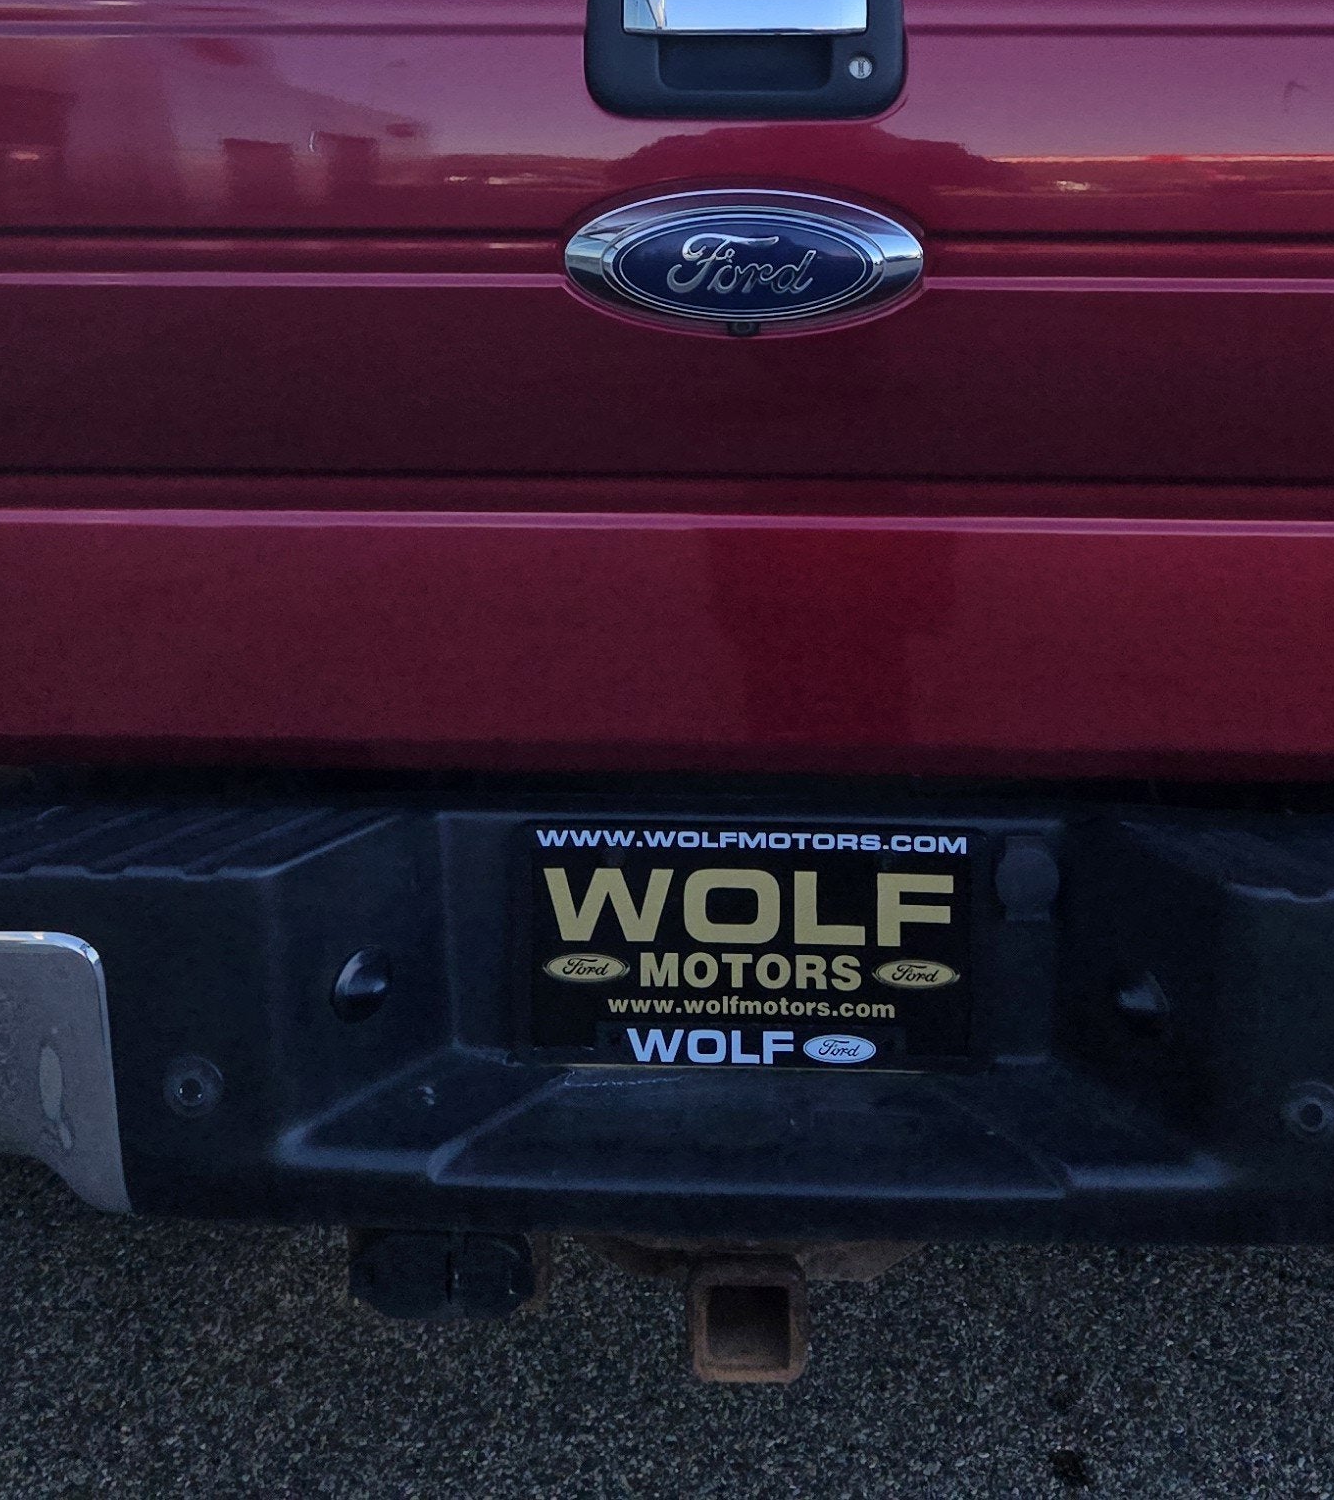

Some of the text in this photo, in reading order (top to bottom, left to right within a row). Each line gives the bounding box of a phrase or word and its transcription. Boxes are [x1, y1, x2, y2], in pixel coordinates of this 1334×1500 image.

[667, 232, 817, 295] Ford
[536, 829, 967, 854] WWW.WOLFMOTORS.COM
[543, 867, 955, 947] WOLF
[562, 952, 939, 991] Ford MOTORS Ford
[608, 996, 896, 1019] www.wolfmotors.com
[627, 1028, 861, 1064] WOLF Ford
